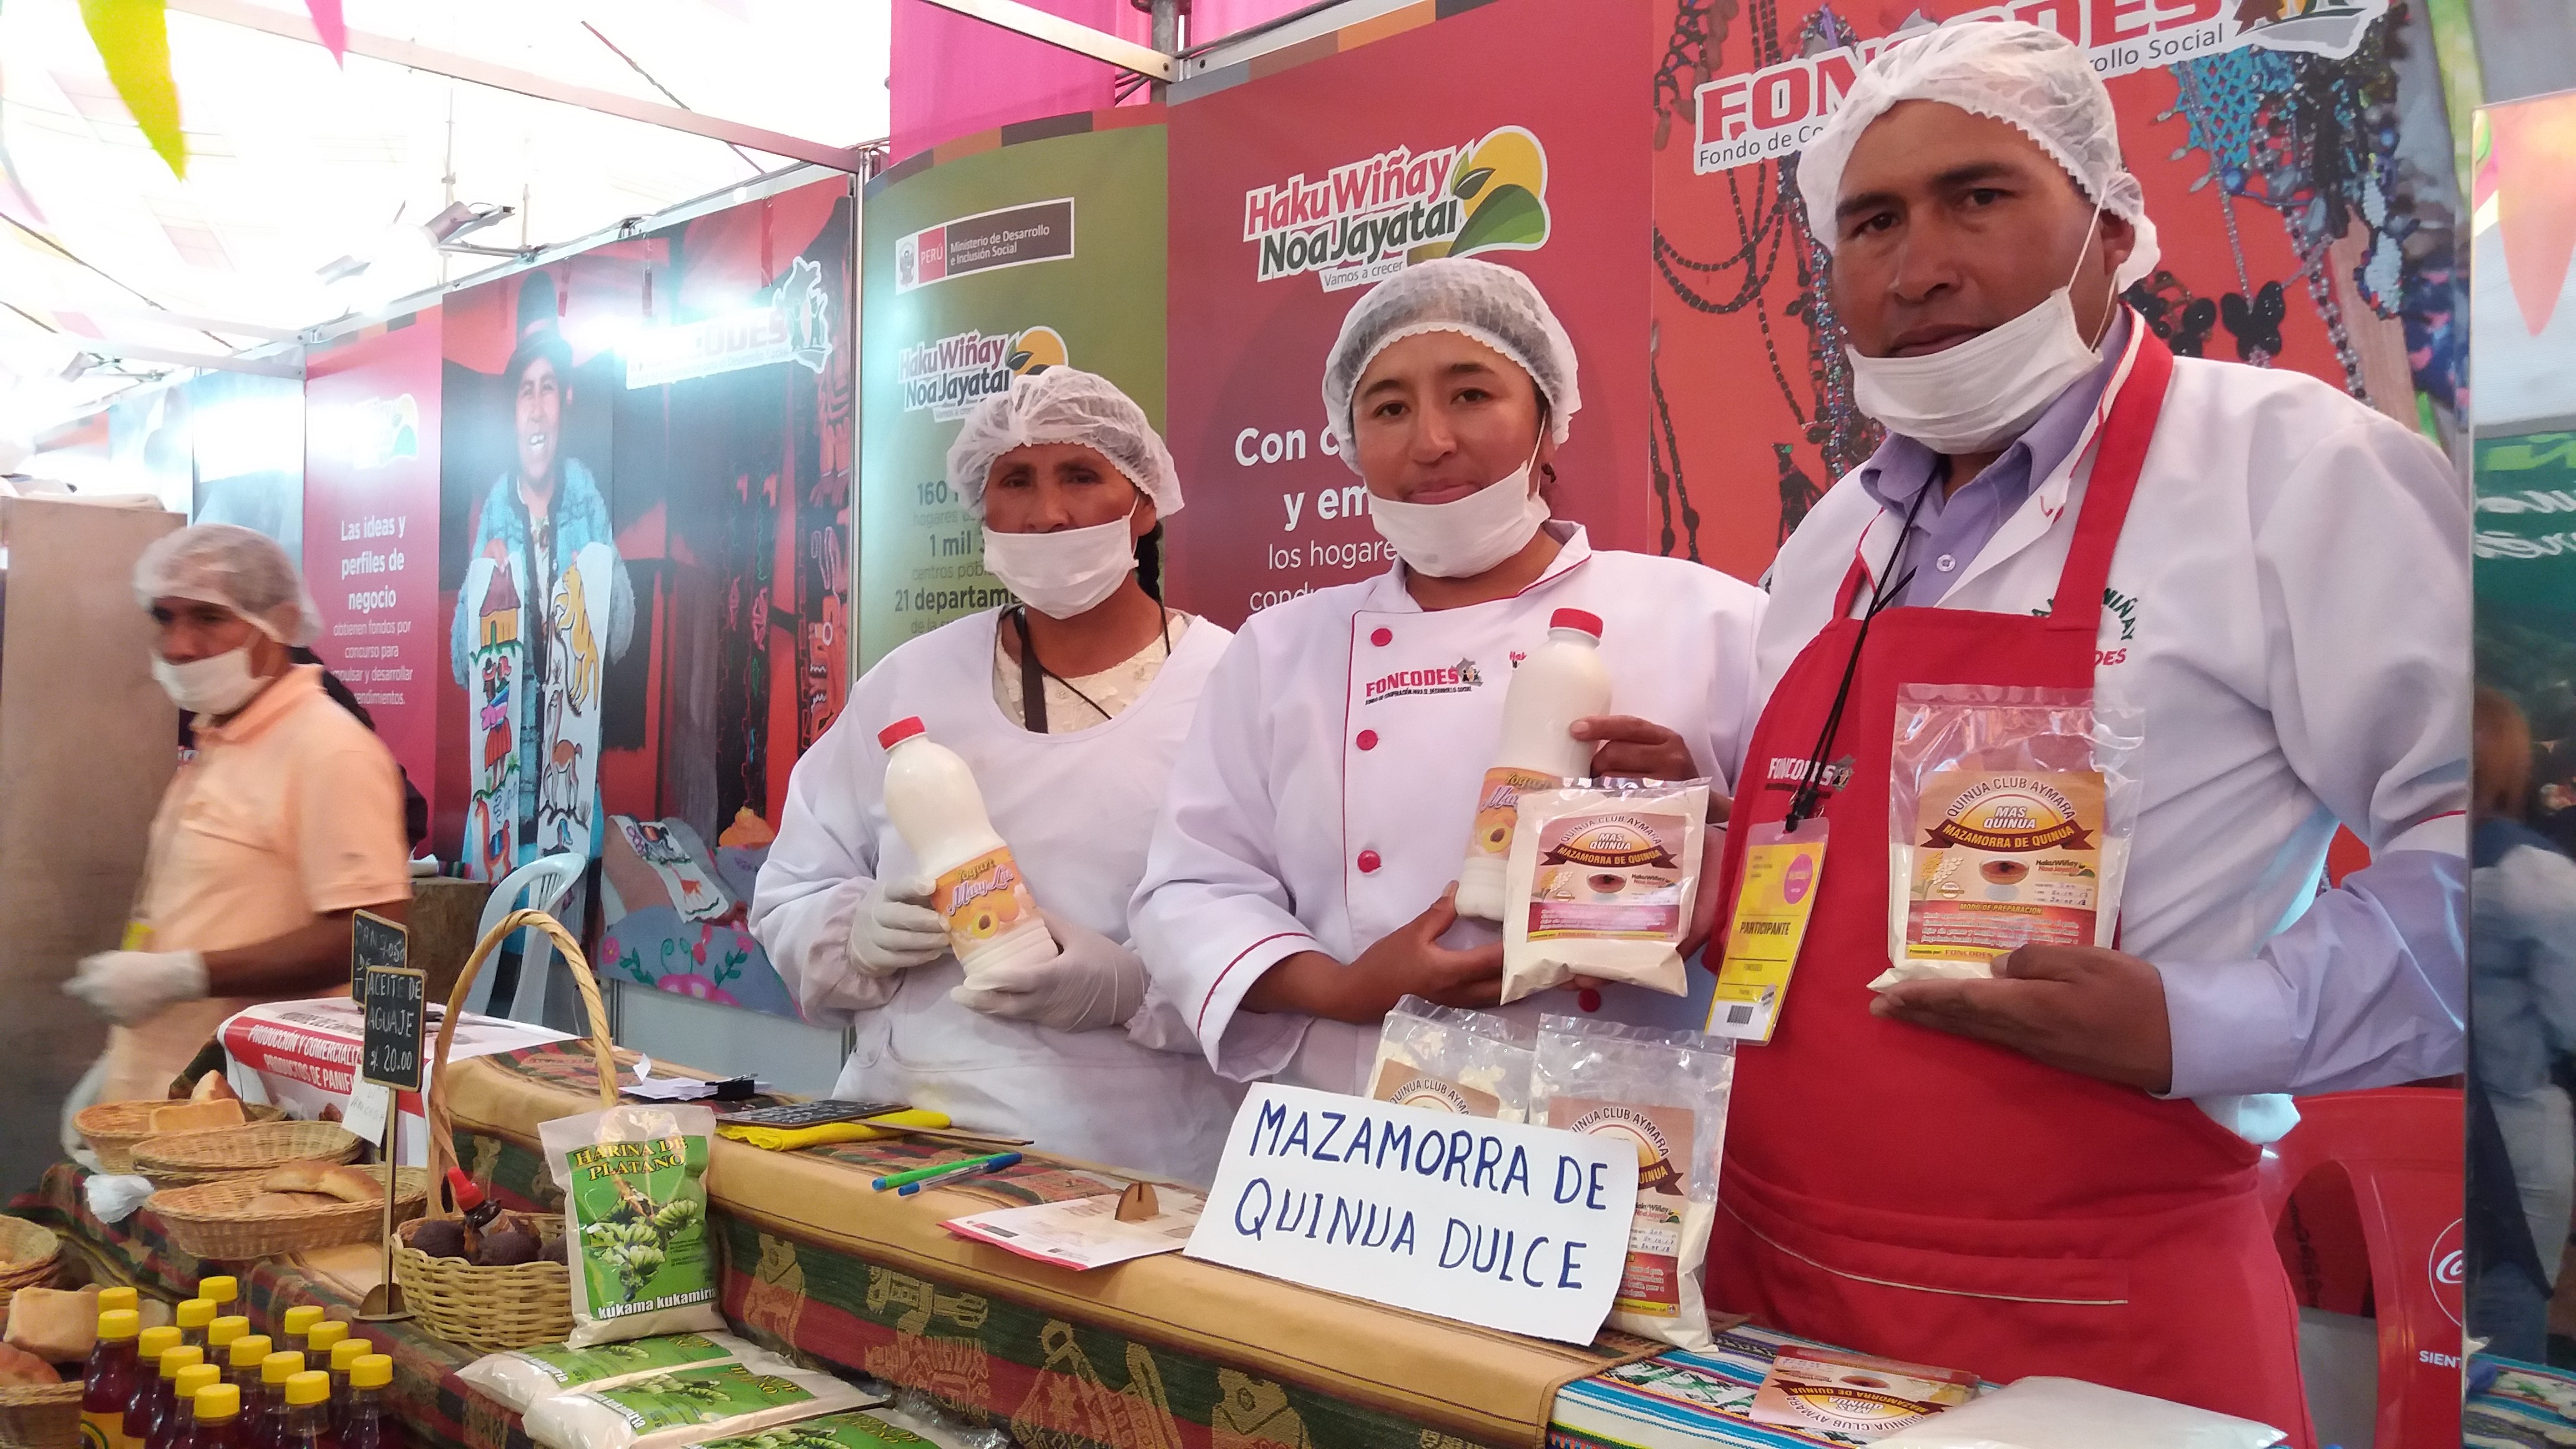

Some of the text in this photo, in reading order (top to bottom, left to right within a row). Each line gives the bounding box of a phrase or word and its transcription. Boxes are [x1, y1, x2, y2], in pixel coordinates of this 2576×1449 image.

[1700, 140, 1760, 167] Fondo
[1768, 131, 1792, 151] de
[2148, 24, 2223, 59] Social
[950, 225, 1050, 254] Ministerio de Desarrollo
[920, 244, 944, 266] PERÚ
[950, 242, 1018, 266] e Inclusión Social
[1324, 260, 1403, 287] Vamos a crecer
[1235, 427, 1305, 466] Con
[917, 480, 947, 506] 160
[913, 510, 958, 529] hogares
[1283, 492, 1305, 532] y
[341, 515, 406, 541] Las ideas y
[929, 534, 936, 557] 1
[943, 530, 972, 557] mil
[1268, 540, 1398, 570] los hogare
[341, 548, 404, 580] perfiles de
[912, 565, 954, 580] centros
[348, 587, 396, 614] negocio
[895, 588, 909, 612] 21
[369, 619, 396, 635] fondos
[397, 621, 412, 636] por
[345, 645, 399, 660] concurso para
[364, 670, 371, 685] y
[371, 666, 413, 682] desarrollar
[1366, 668, 1460, 698] FONCODES
[1946, 777, 2076, 820] QUINUA CLUB AYMARA
[1983, 817, 2036, 829] QUINUA
[1994, 806, 2027, 818] MAS
[1561, 815, 1662, 845] QUINUA CLUB AYMARA
[1598, 832, 1624, 842] MAS
[1943, 823, 2076, 849] MAZAMORRA DE QUINUA
[1557, 846, 1663, 866] MAZAMORRA DE QUINUA
[1589, 841, 1632, 851] QUINUA
[1959, 903, 2042, 915] MODO DE PREPARACIÓN
[1739, 921, 1792, 935] PARTICIPANTE
[368, 972, 405, 998] ACEITE
[408, 977, 422, 1002] DE
[368, 1005, 414, 1038] AGUAJE
[248, 1024, 363, 1066] PRODUCCIÓN Y COMERCIALIZ
[383, 1043, 413, 1073] 20.00
[263, 1053, 311, 1083] PRODUCTOS
[309, 1065, 322, 1087] DE
[1423, 1078, 1448, 1094] CLUB
[1603, 1107, 1631, 1121] CLUB
[1632, 1113, 1670, 1158] AYMARA
[575, 1136, 688, 1168] HARINA DE
[1249, 1098, 1608, 1210] MAZAMORRA DE
[588, 1154, 686, 1181] PLATANO
[1639, 1164, 1669, 1184] UINUA
[1234, 1177, 1589, 1290] QUINUA DULCE
[597, 1299, 654, 1320] kukama
[1785, 1395, 1828, 1423] AYMARA
[1828, 1396, 1885, 1411] QUINUA
[1835, 1404, 1872, 1415] MAS
[1832, 1419, 1870, 1432] CLUB
